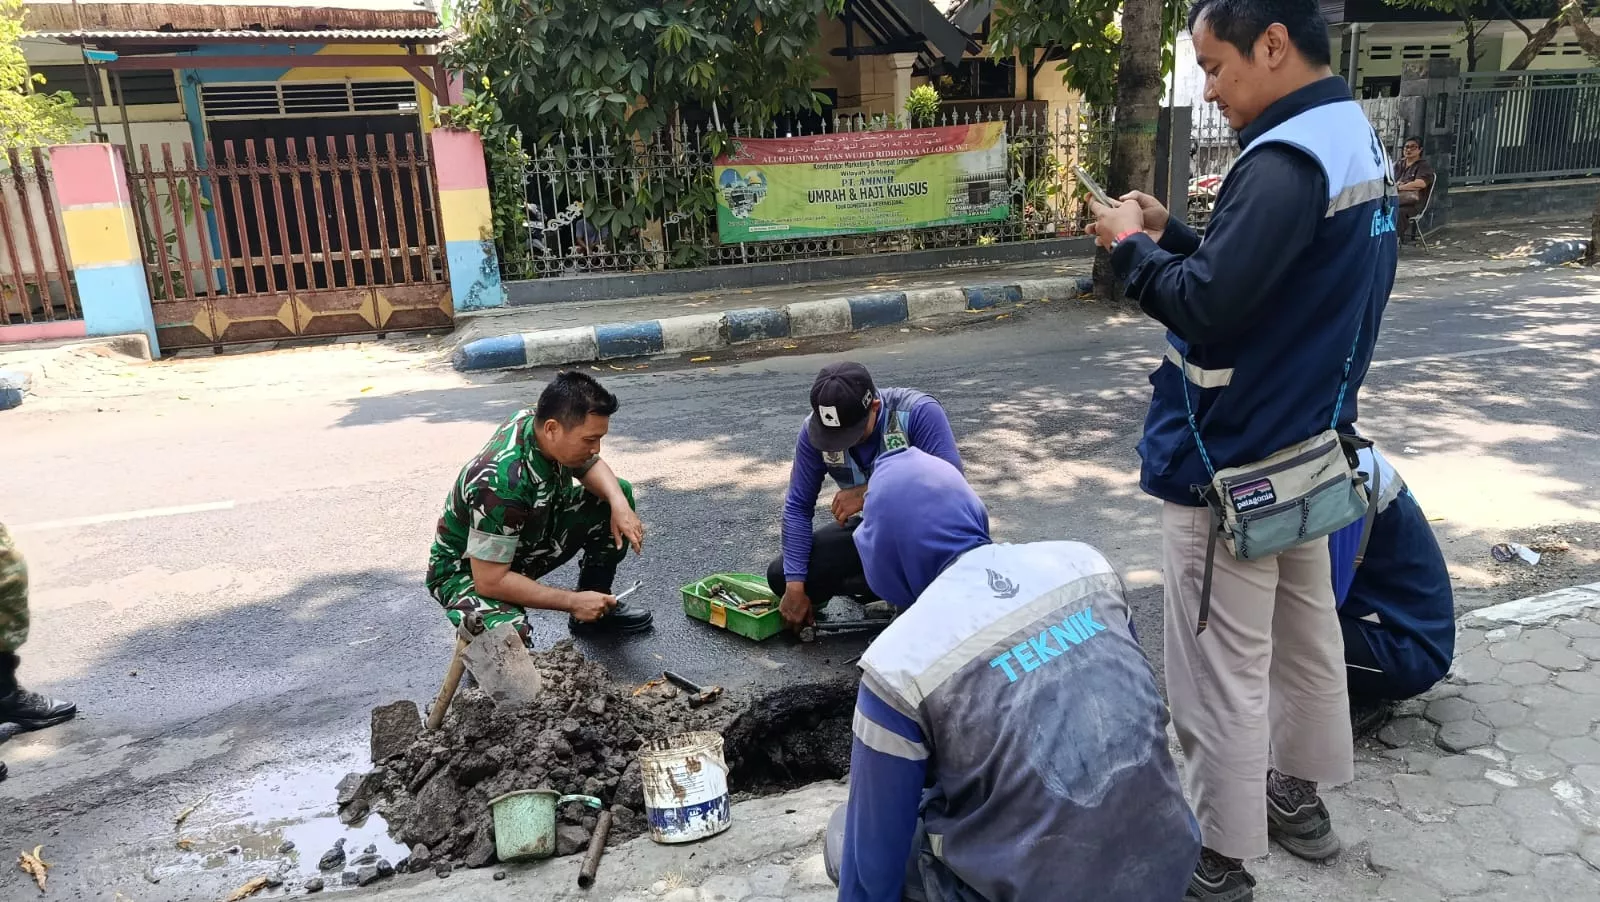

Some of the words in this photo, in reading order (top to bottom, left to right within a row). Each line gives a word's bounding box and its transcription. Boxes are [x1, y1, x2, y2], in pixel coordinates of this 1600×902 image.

[762, 153, 820, 163] ALLOHUMMA
[822, 152, 844, 161] ATAS
[844, 151, 874, 160] WUJUD
[876, 148, 920, 158] RIDHONYA
[921, 145, 947, 155] ALLOH
[813, 162, 843, 170] Koordinator
[845, 159, 871, 169] Marketing
[840, 170, 866, 178] Wilayah
[808, 189, 846, 204] UMRAH
[849, 187, 858, 201] &
[860, 185, 884, 200] HAJI
[887, 182, 929, 198] KHUSUS
[1236, 492, 1274, 510] patagonia
[988, 607, 1108, 683] TEKNIK
